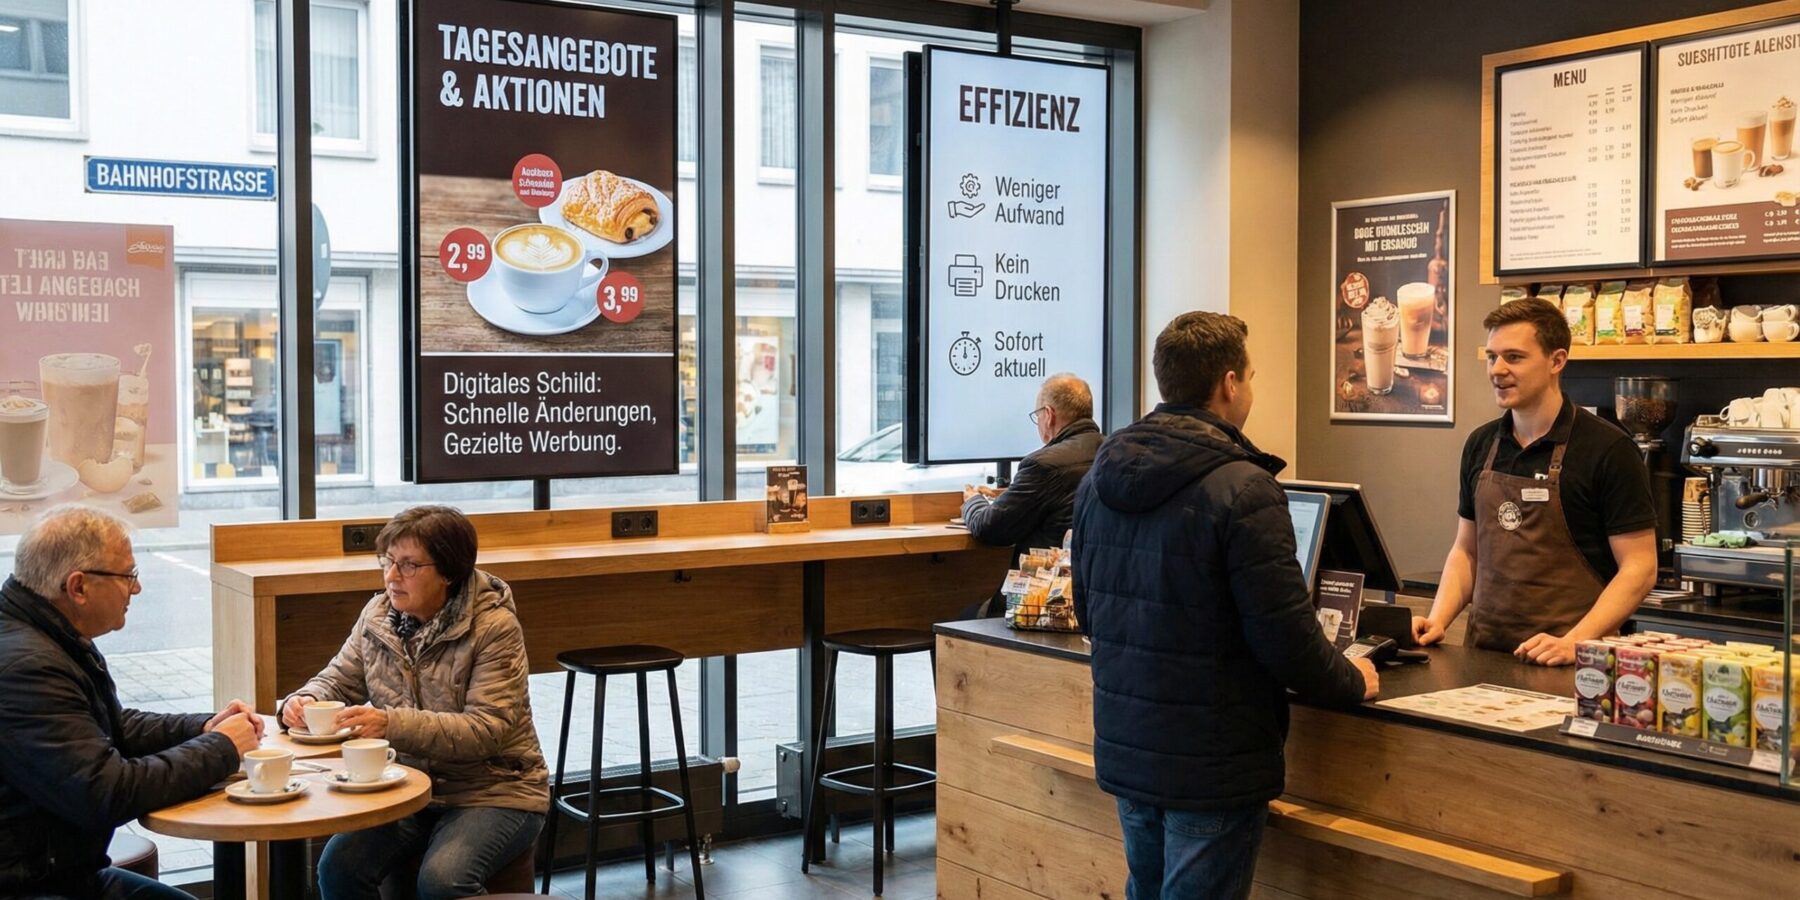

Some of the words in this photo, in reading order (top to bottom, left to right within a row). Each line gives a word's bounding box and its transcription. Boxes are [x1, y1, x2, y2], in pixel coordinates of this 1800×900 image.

[438, 23, 658, 80] TAGESANGEBOTE
[1553, 68, 1587, 88] MENU
[439, 70, 464, 107] &
[472, 73, 605, 119] AKTIONEN
[960, 84, 1081, 133] EFFIZIENZ
[96, 163, 268, 193] BAHNHOFSTRASSE
[995, 176, 1061, 203] Weniger
[995, 202, 1065, 226] Aufwand
[1365, 240, 1379, 252] MIT
[995, 252, 1029, 274] Kein
[995, 279, 1060, 302] Drucken
[994, 330, 1044, 352] Sofort
[994, 357, 1046, 378] aktuell
[444, 371, 531, 399] Digitales
[536, 371, 602, 394] Schild:
[444, 401, 530, 425] Schnelle
[535, 396, 657, 427] Änderungen,
[444, 431, 523, 455] Gezielte
[528, 430, 622, 456] Werbung.
